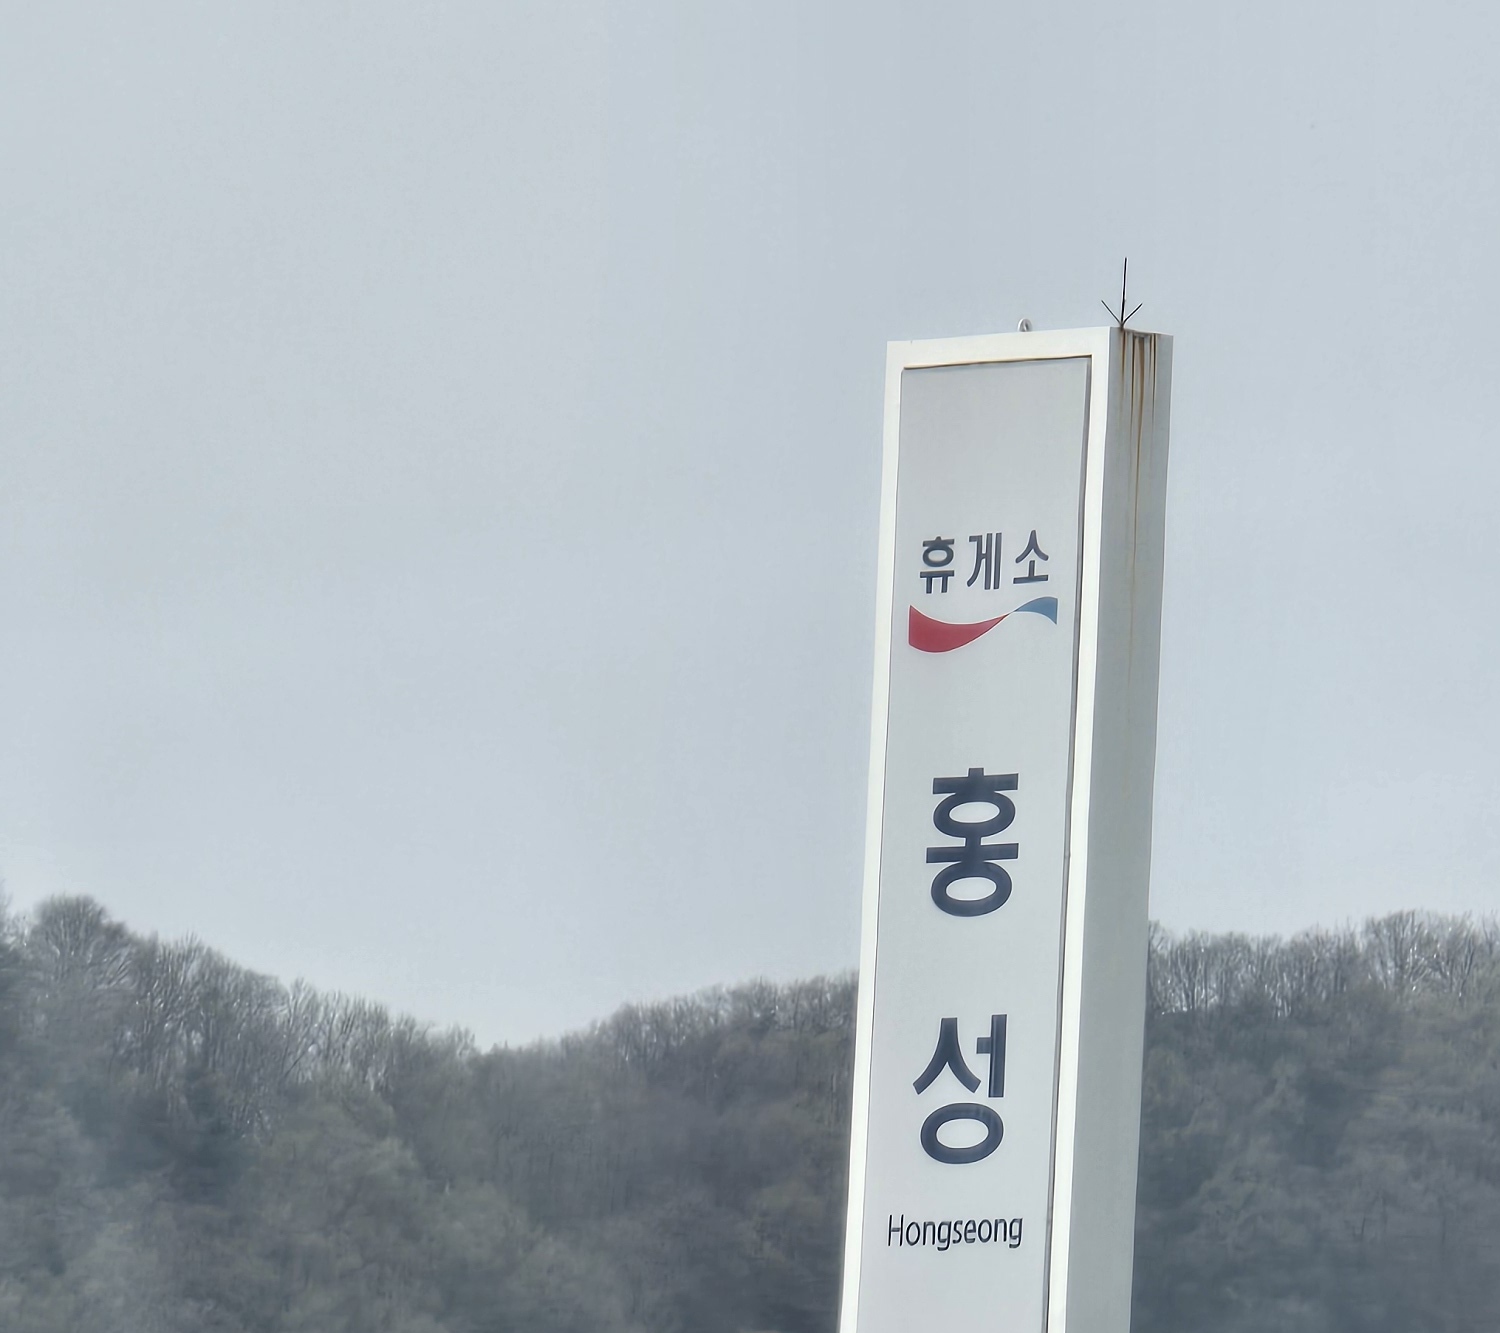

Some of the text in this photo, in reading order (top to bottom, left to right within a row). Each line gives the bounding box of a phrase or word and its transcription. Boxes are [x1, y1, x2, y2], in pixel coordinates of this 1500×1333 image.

[918, 529, 1050, 595] 휴게소
[912, 766, 1020, 1166] 홍성
[887, 1213, 1024, 1251] Hongseong
